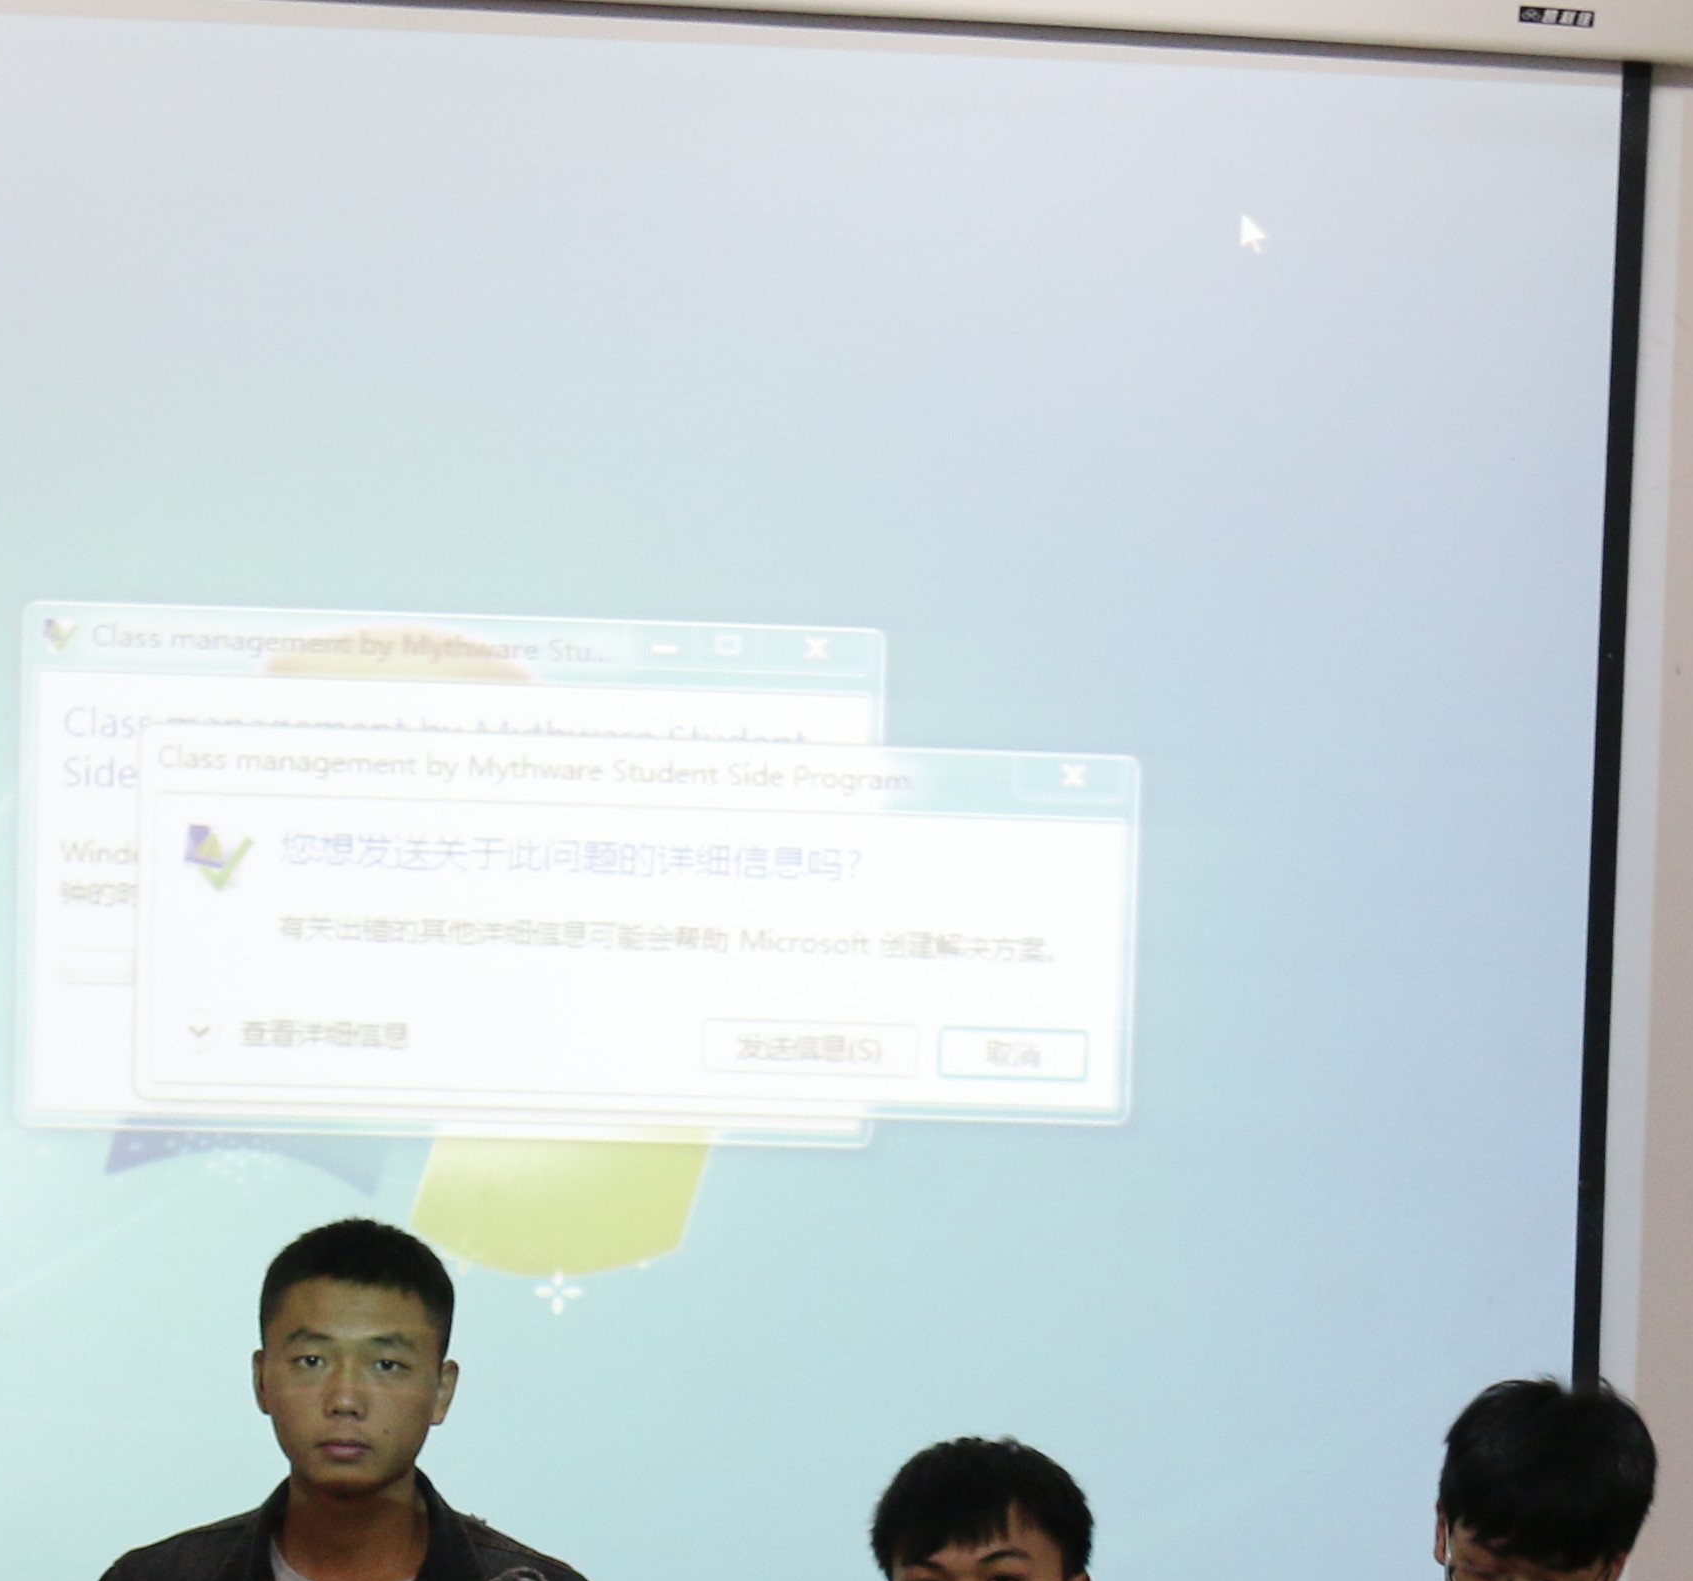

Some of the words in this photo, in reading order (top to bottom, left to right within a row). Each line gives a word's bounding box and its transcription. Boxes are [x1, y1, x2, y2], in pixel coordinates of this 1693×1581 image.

[92, 624, 161, 650] Class
[170, 629, 346, 656] management
[360, 633, 393, 659] by
[402, 635, 538, 664] Mythware
[158, 744, 226, 771] Class
[236, 749, 416, 778] management
[427, 751, 458, 783] by
[469, 754, 602, 784] Mythware
[613, 759, 718, 786] Student
[728, 763, 784, 789] Side
[794, 765, 910, 796] Program
[740, 929, 869, 956] Microsoft
[985, 1039, 1041, 1069] 取消
